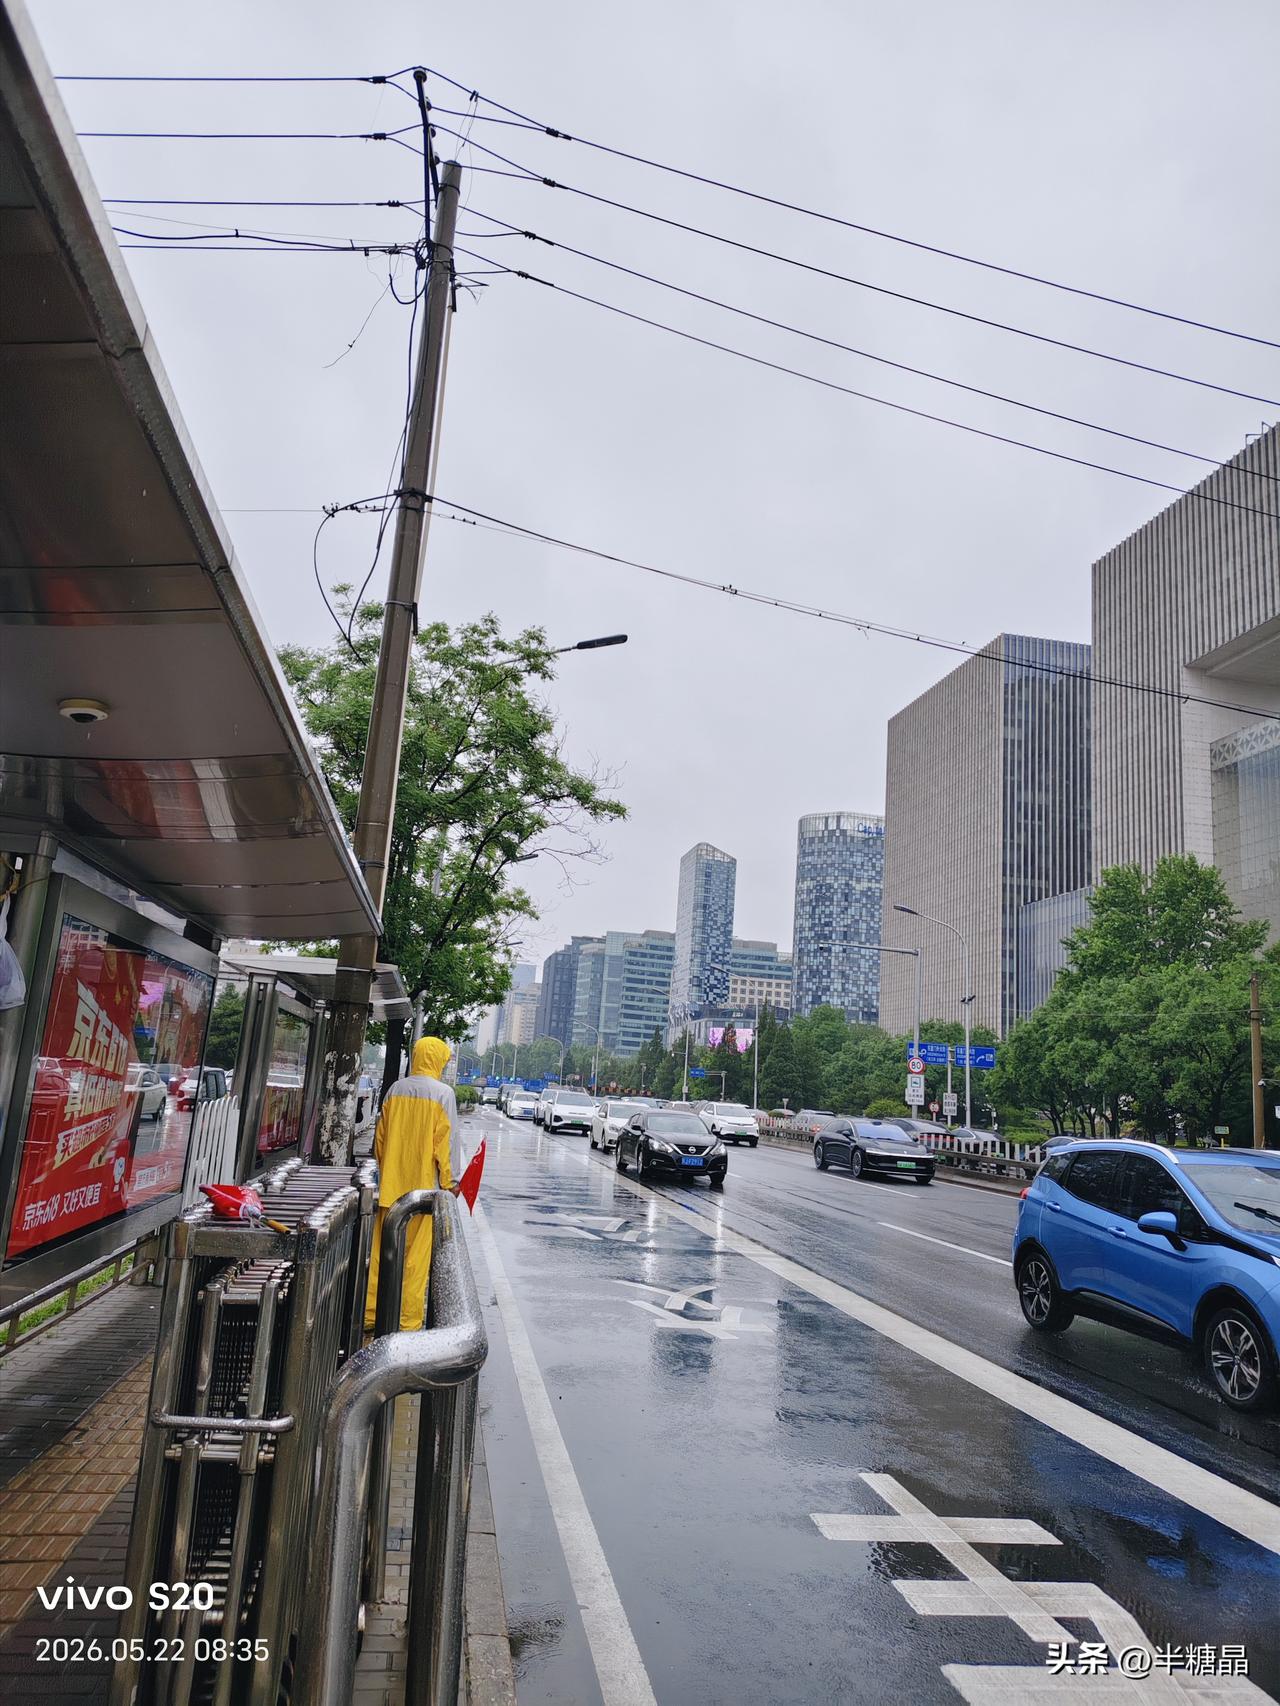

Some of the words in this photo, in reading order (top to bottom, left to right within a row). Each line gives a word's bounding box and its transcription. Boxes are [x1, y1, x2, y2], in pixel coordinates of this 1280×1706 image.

[66, 979, 129, 1076] 京东618
[23, 1193, 60, 1230] 京东618
[61, 1182, 102, 1217] 又好又便宜
